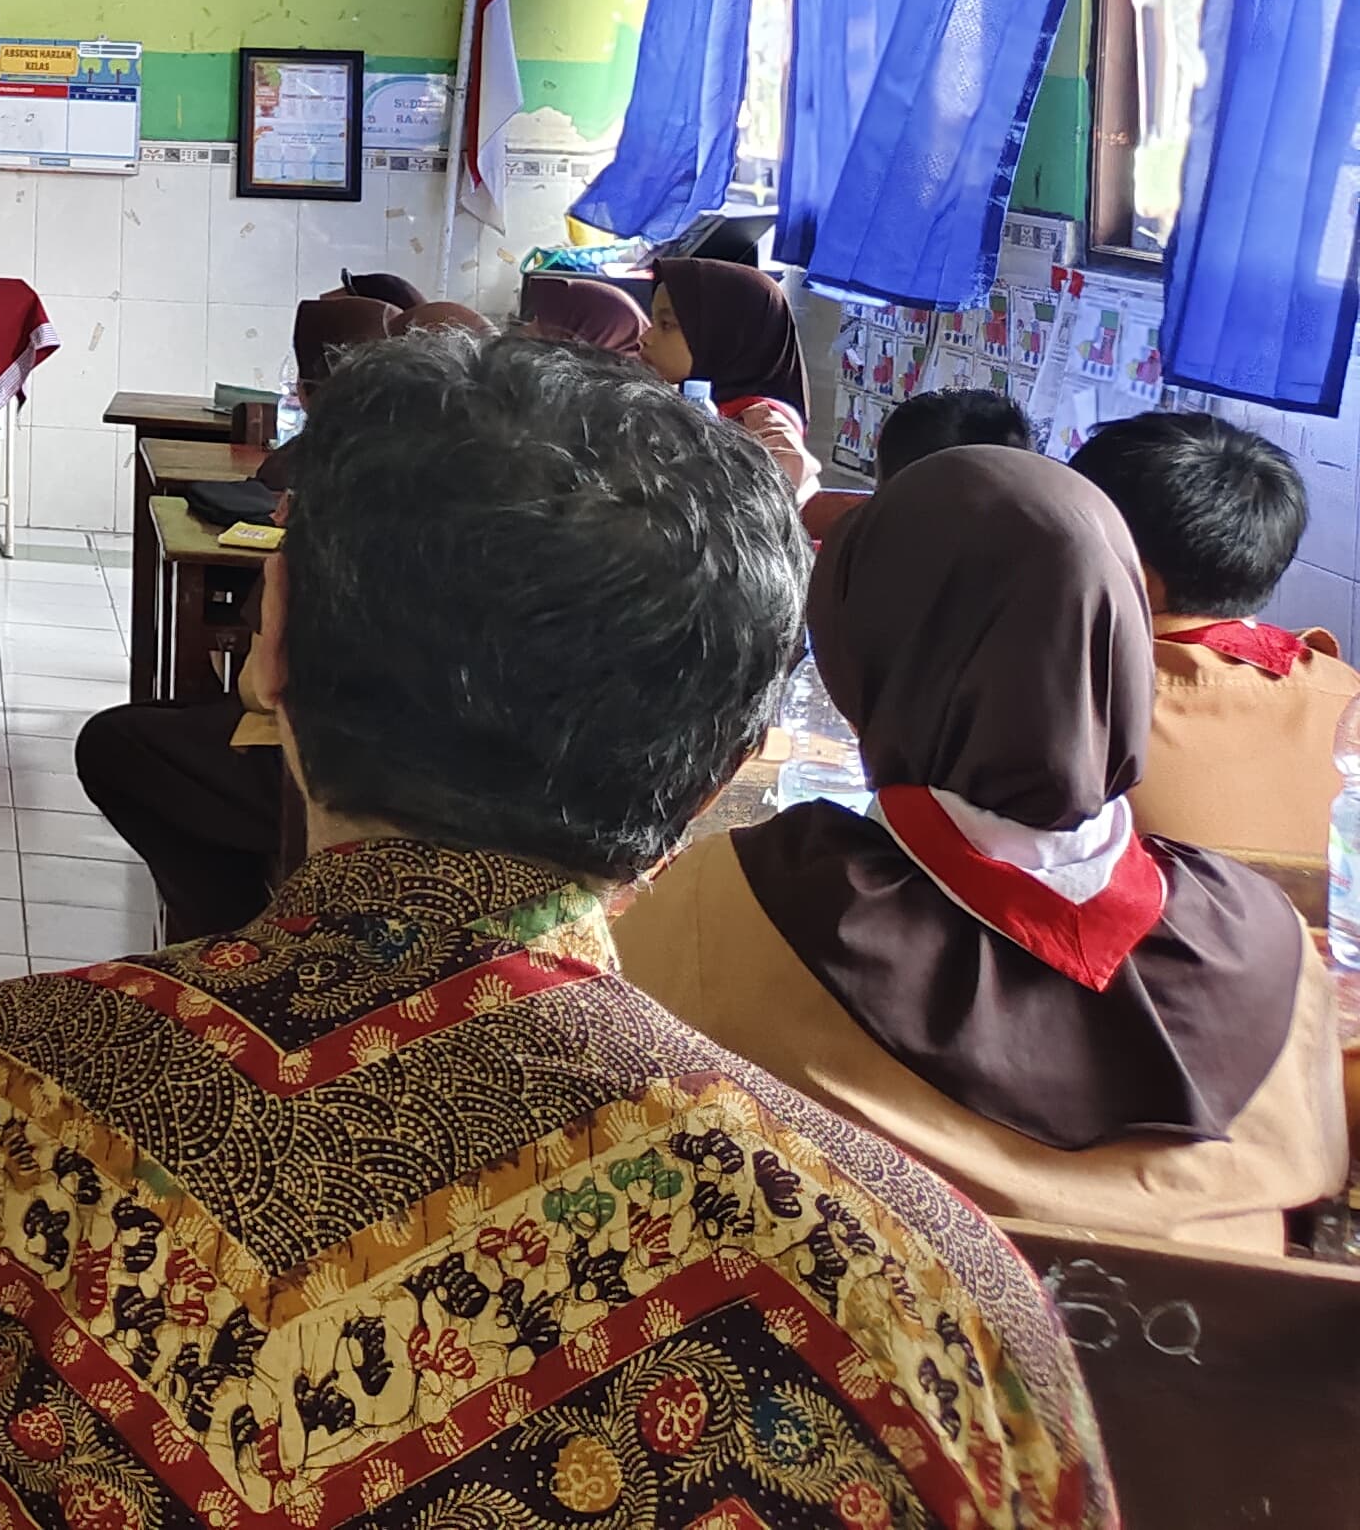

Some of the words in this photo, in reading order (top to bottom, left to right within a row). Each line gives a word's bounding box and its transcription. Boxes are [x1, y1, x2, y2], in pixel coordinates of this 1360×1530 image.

[4, 48, 38, 60] ABSENSI
[39, 49, 72, 60] HARIAN
[25, 62, 50, 71] KELAS
